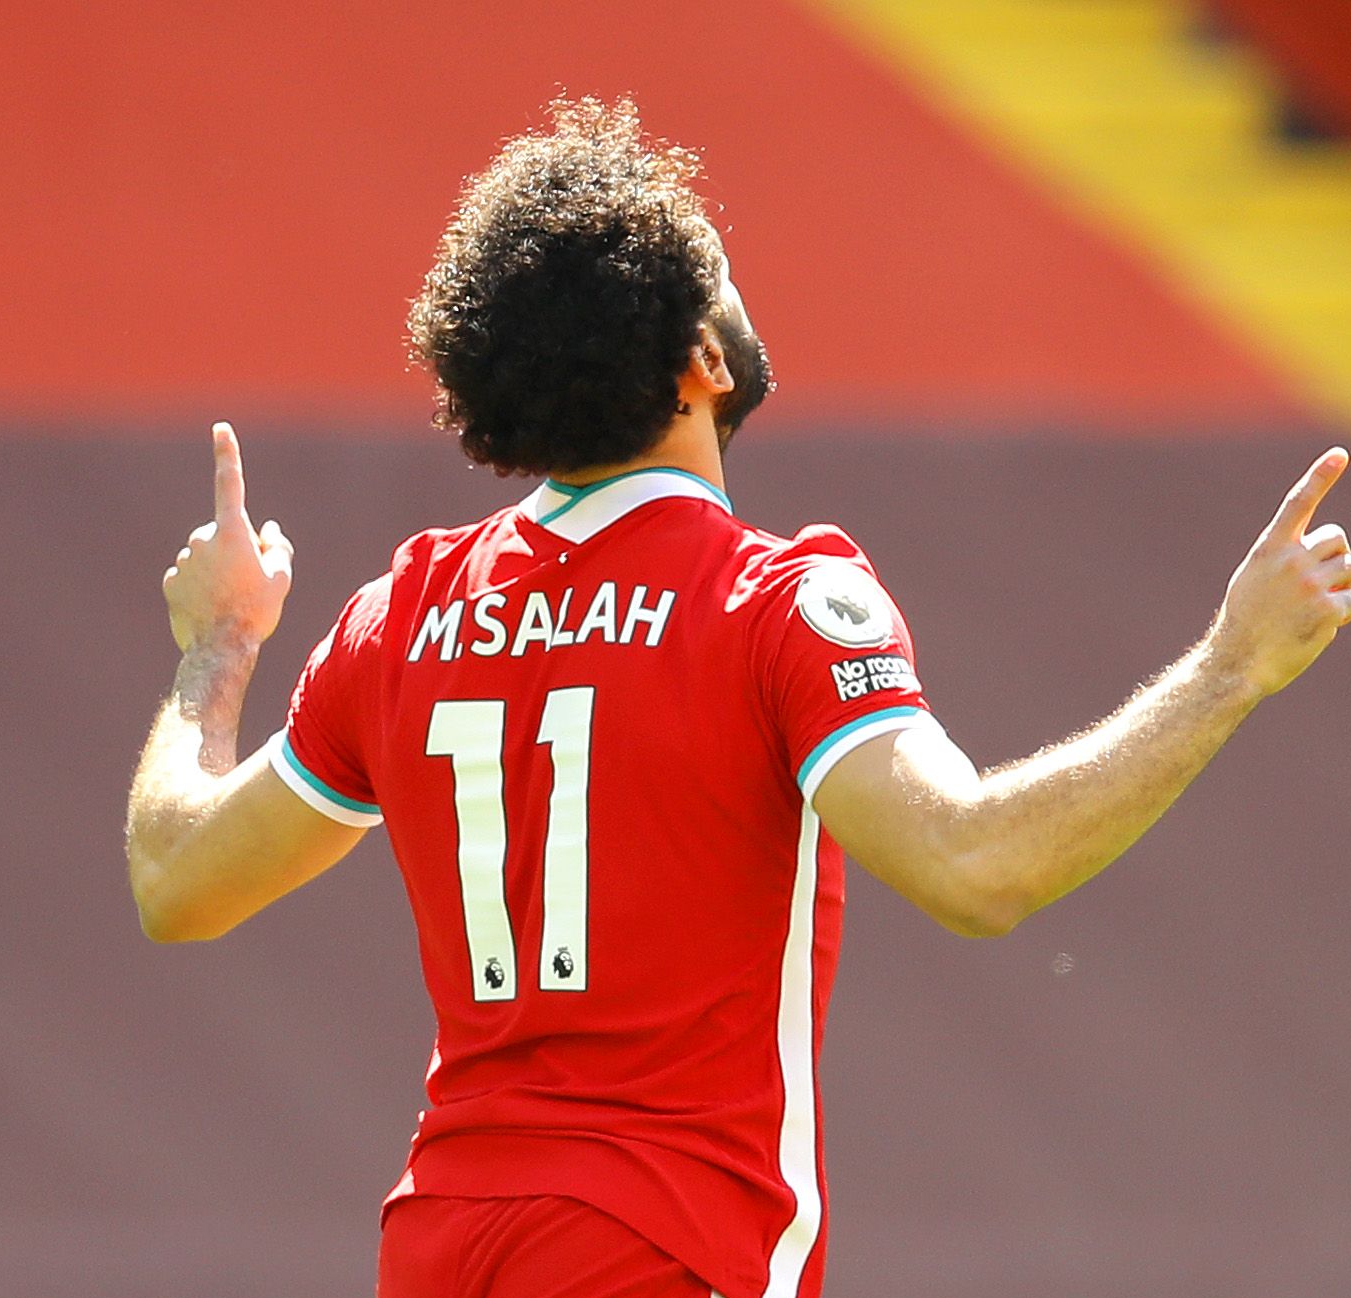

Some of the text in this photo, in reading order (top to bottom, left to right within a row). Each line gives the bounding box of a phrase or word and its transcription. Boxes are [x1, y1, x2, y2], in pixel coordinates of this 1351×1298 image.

[831, 660, 866, 683] No
[837, 677, 868, 702] for
[425, 686, 595, 1002] 11
